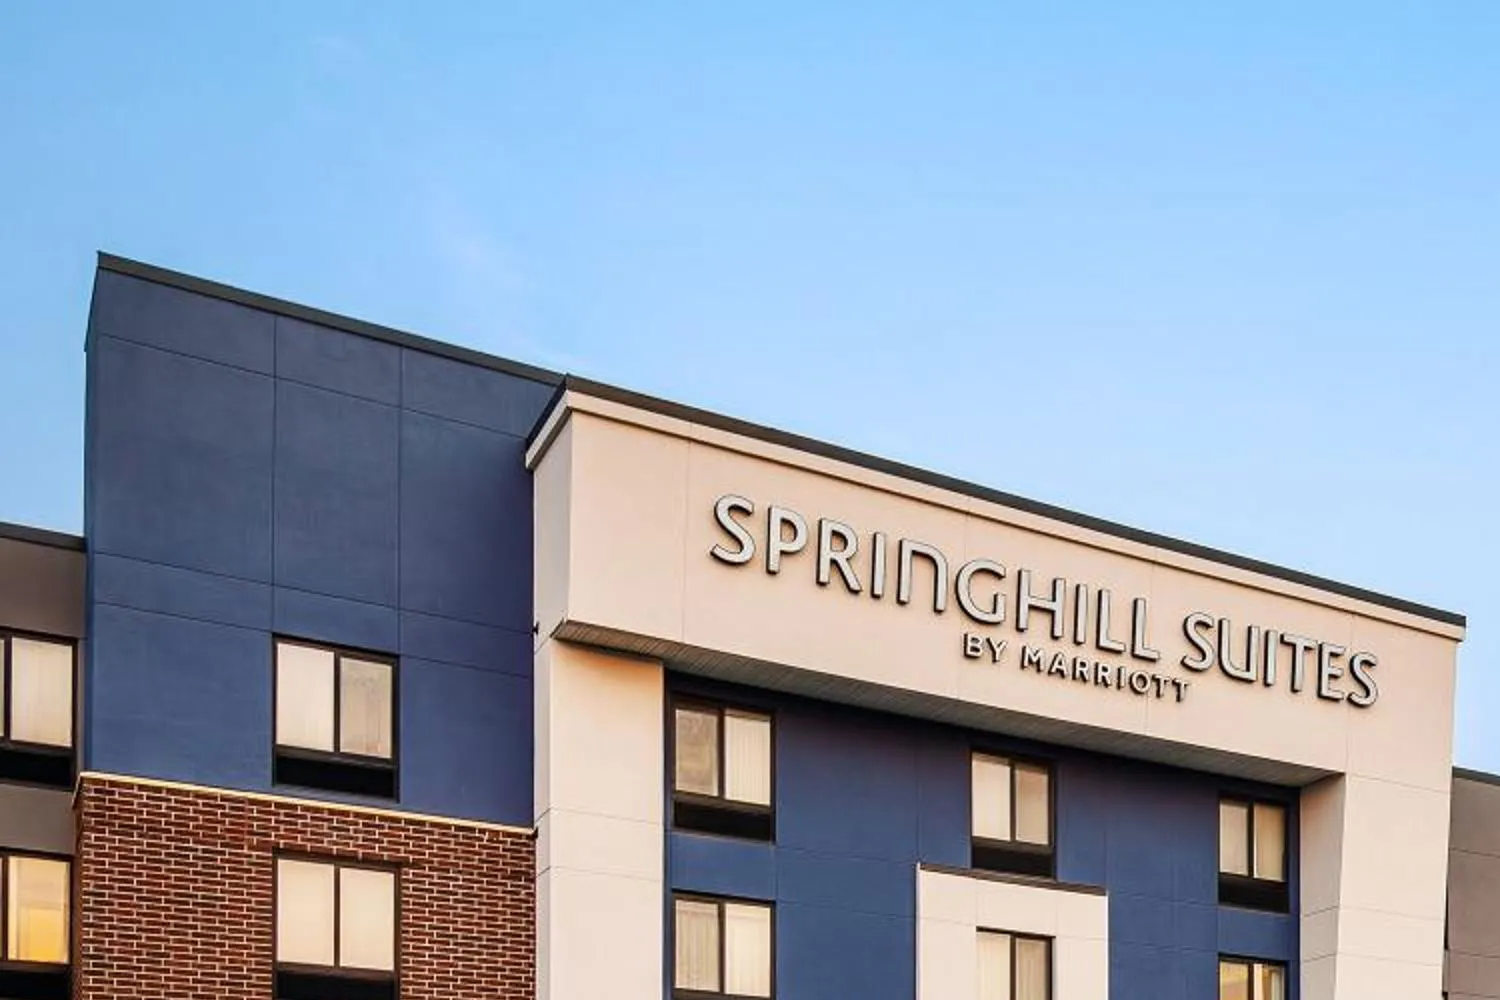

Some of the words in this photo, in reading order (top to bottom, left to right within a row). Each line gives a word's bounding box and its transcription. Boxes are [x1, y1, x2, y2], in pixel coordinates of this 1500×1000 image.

[710, 494, 1161, 662] SPRINGHILL
[1180, 611, 1379, 707] SUITES
[963, 632, 1009, 661] BY
[1020, 646, 1191, 701] MARRIOTT
